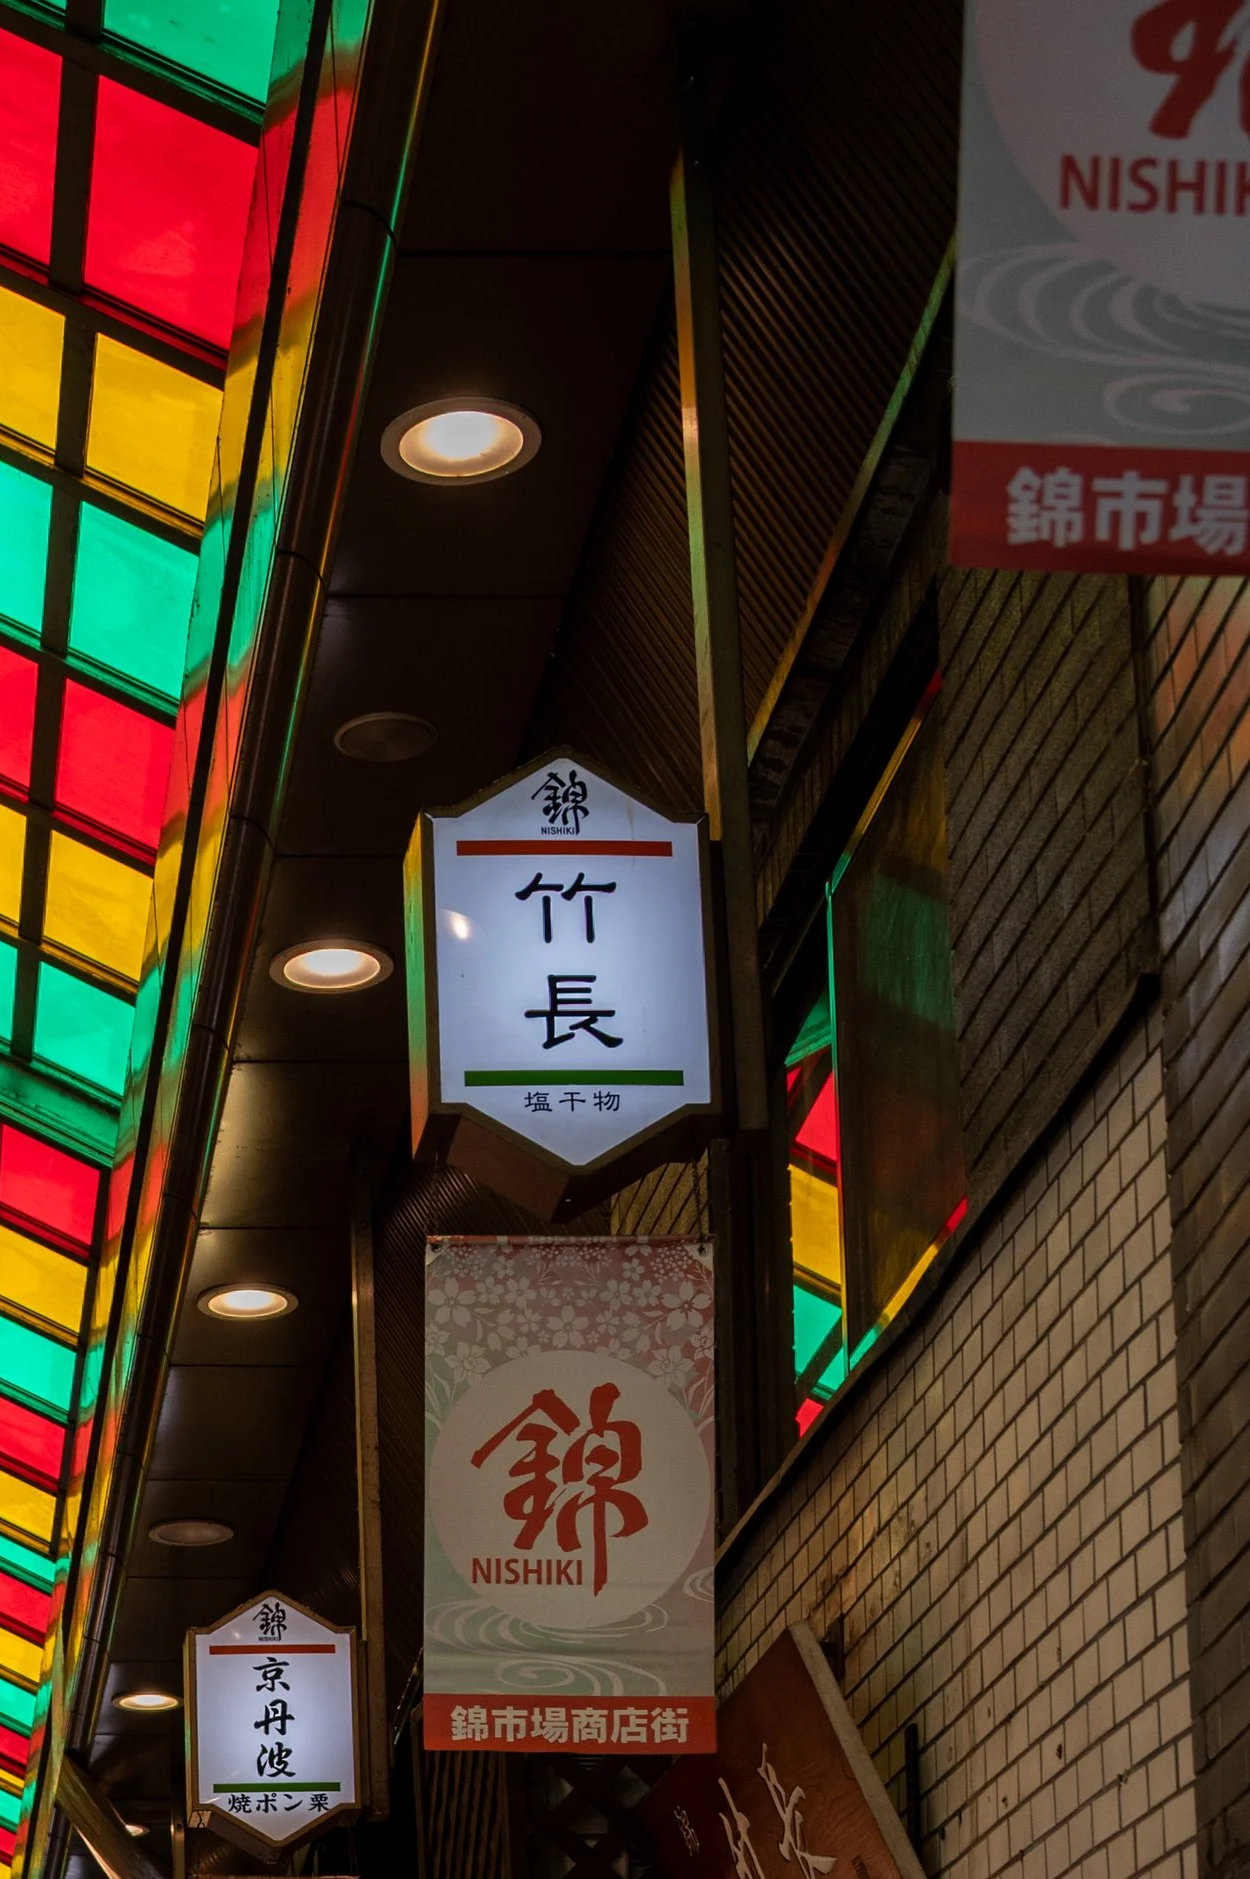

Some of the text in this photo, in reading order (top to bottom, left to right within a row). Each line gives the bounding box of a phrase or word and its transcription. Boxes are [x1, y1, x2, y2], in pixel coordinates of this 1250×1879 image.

[1006, 465, 1250, 557] 錦市場
[531, 769, 590, 837] 錦
[540, 825, 576, 836] NISHIKI
[514, 871, 625, 1050] 竹長
[523, 1090, 622, 1114] 塩干物
[470, 1381, 650, 1598] 錦
[470, 1556, 584, 1587] NISHIKI
[252, 1601, 288, 1642] 錦
[252, 1656, 296, 1778] 京丹波
[449, 1704, 690, 1746] 錦市場商店街
[227, 1792, 330, 1814] 焼ポン栗
